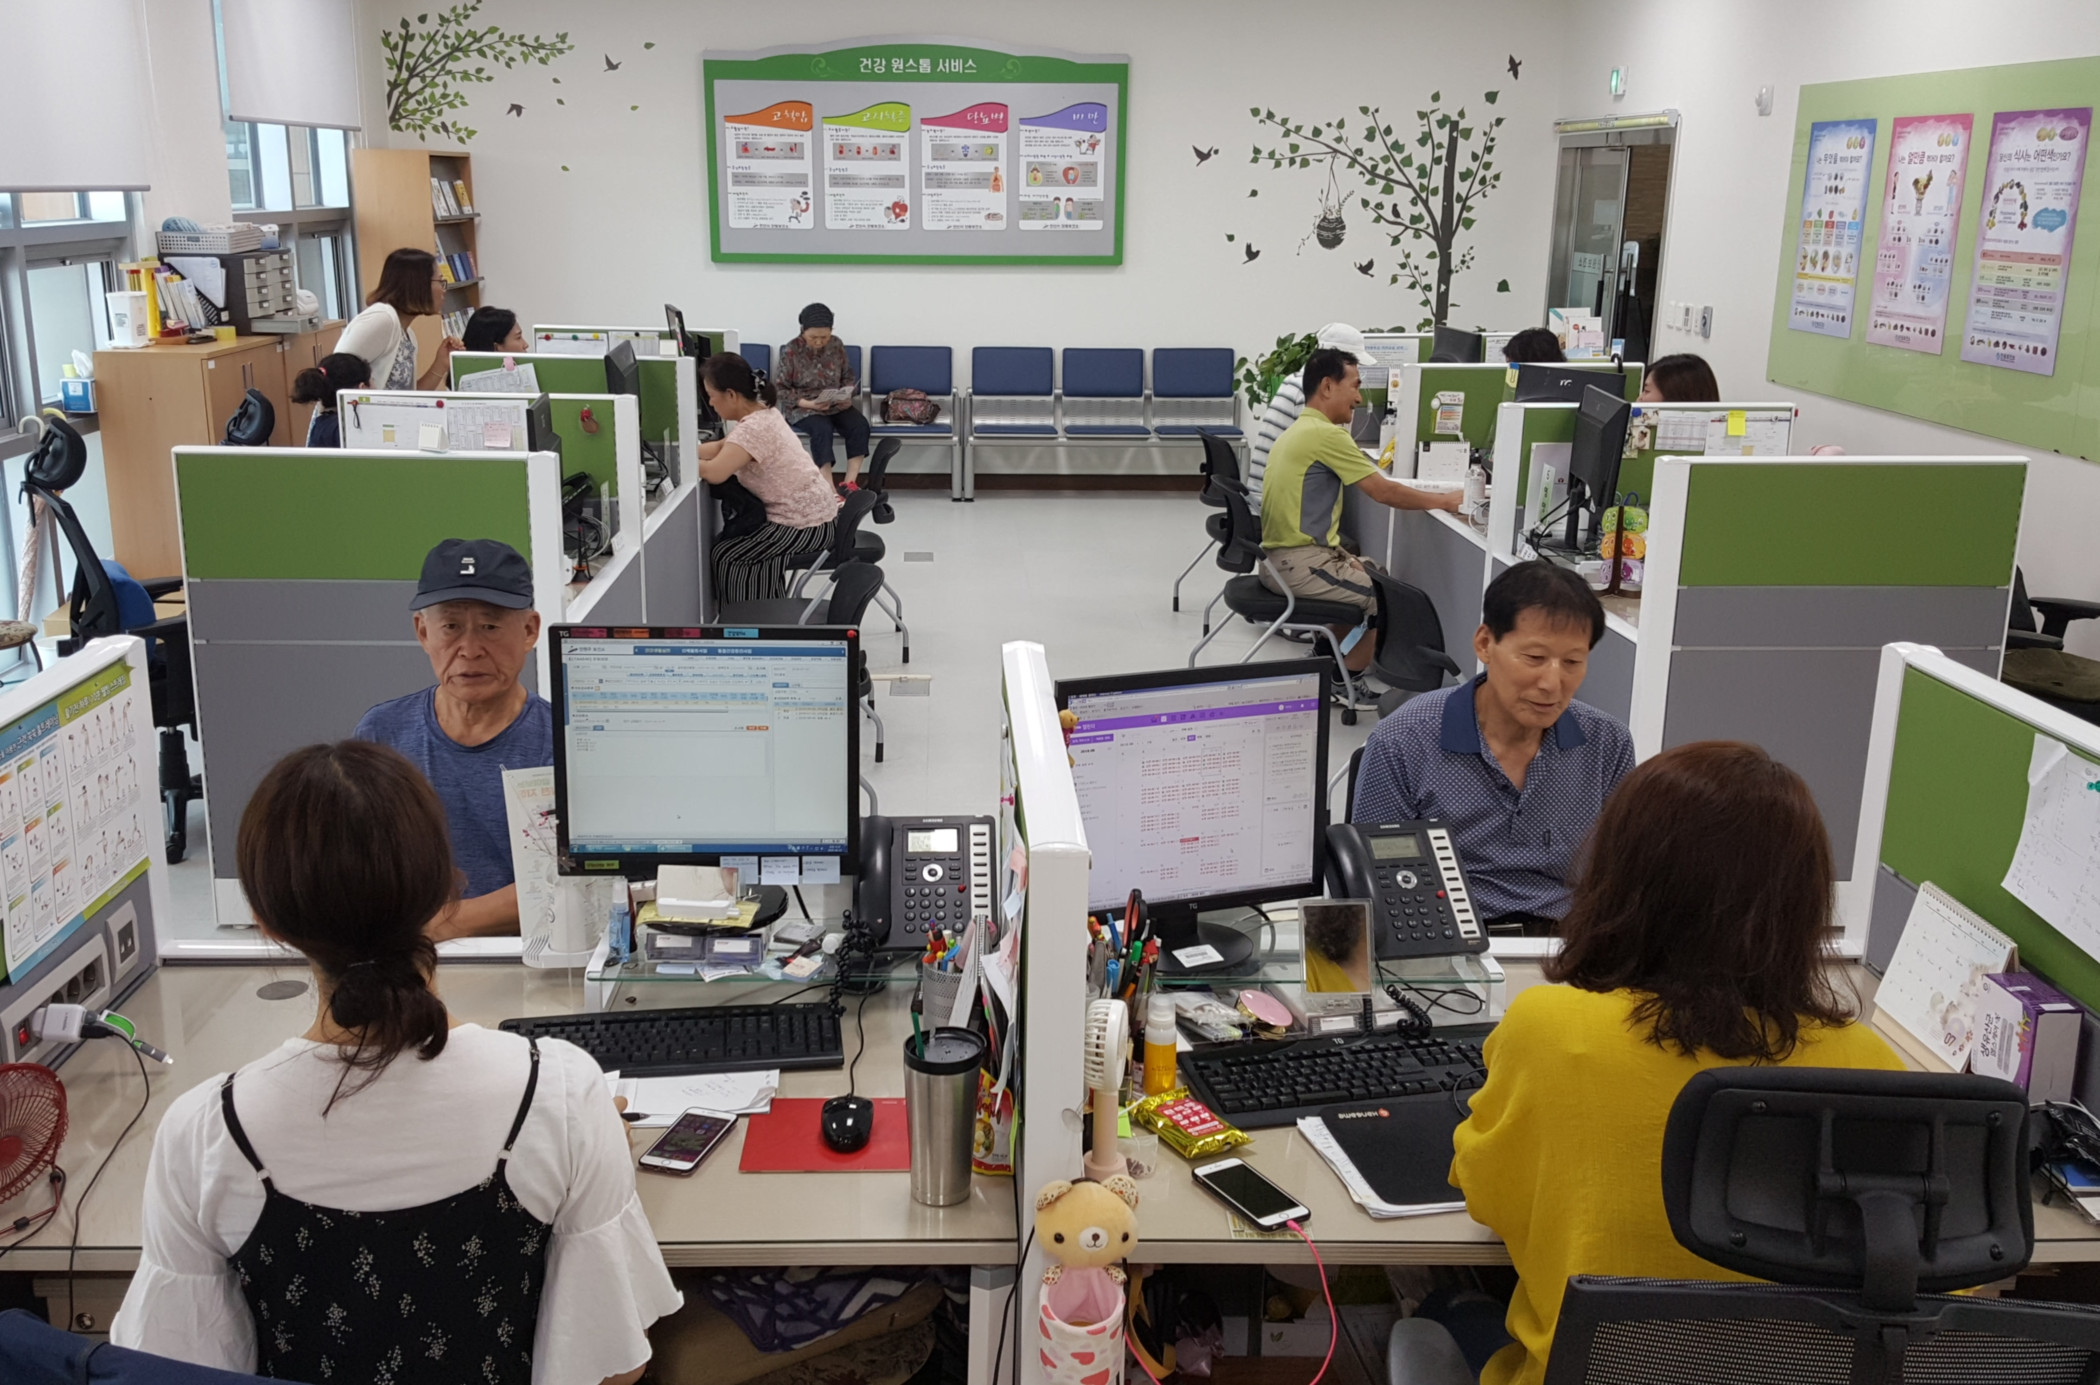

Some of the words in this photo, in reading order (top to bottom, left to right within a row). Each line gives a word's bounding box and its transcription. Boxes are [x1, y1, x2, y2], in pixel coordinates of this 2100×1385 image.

[859, 57, 886, 73] 건강
[891, 58, 931, 73] 원스톱
[937, 58, 977, 74] 서비스
[967, 111, 1004, 125] 당뇨병
[1072, 112, 1099, 125] 비만
[1823, 152, 1838, 165] 무엇을
[2014, 148, 2032, 163] 식사는
[1980, 1013, 1994, 1057] 생유산균
